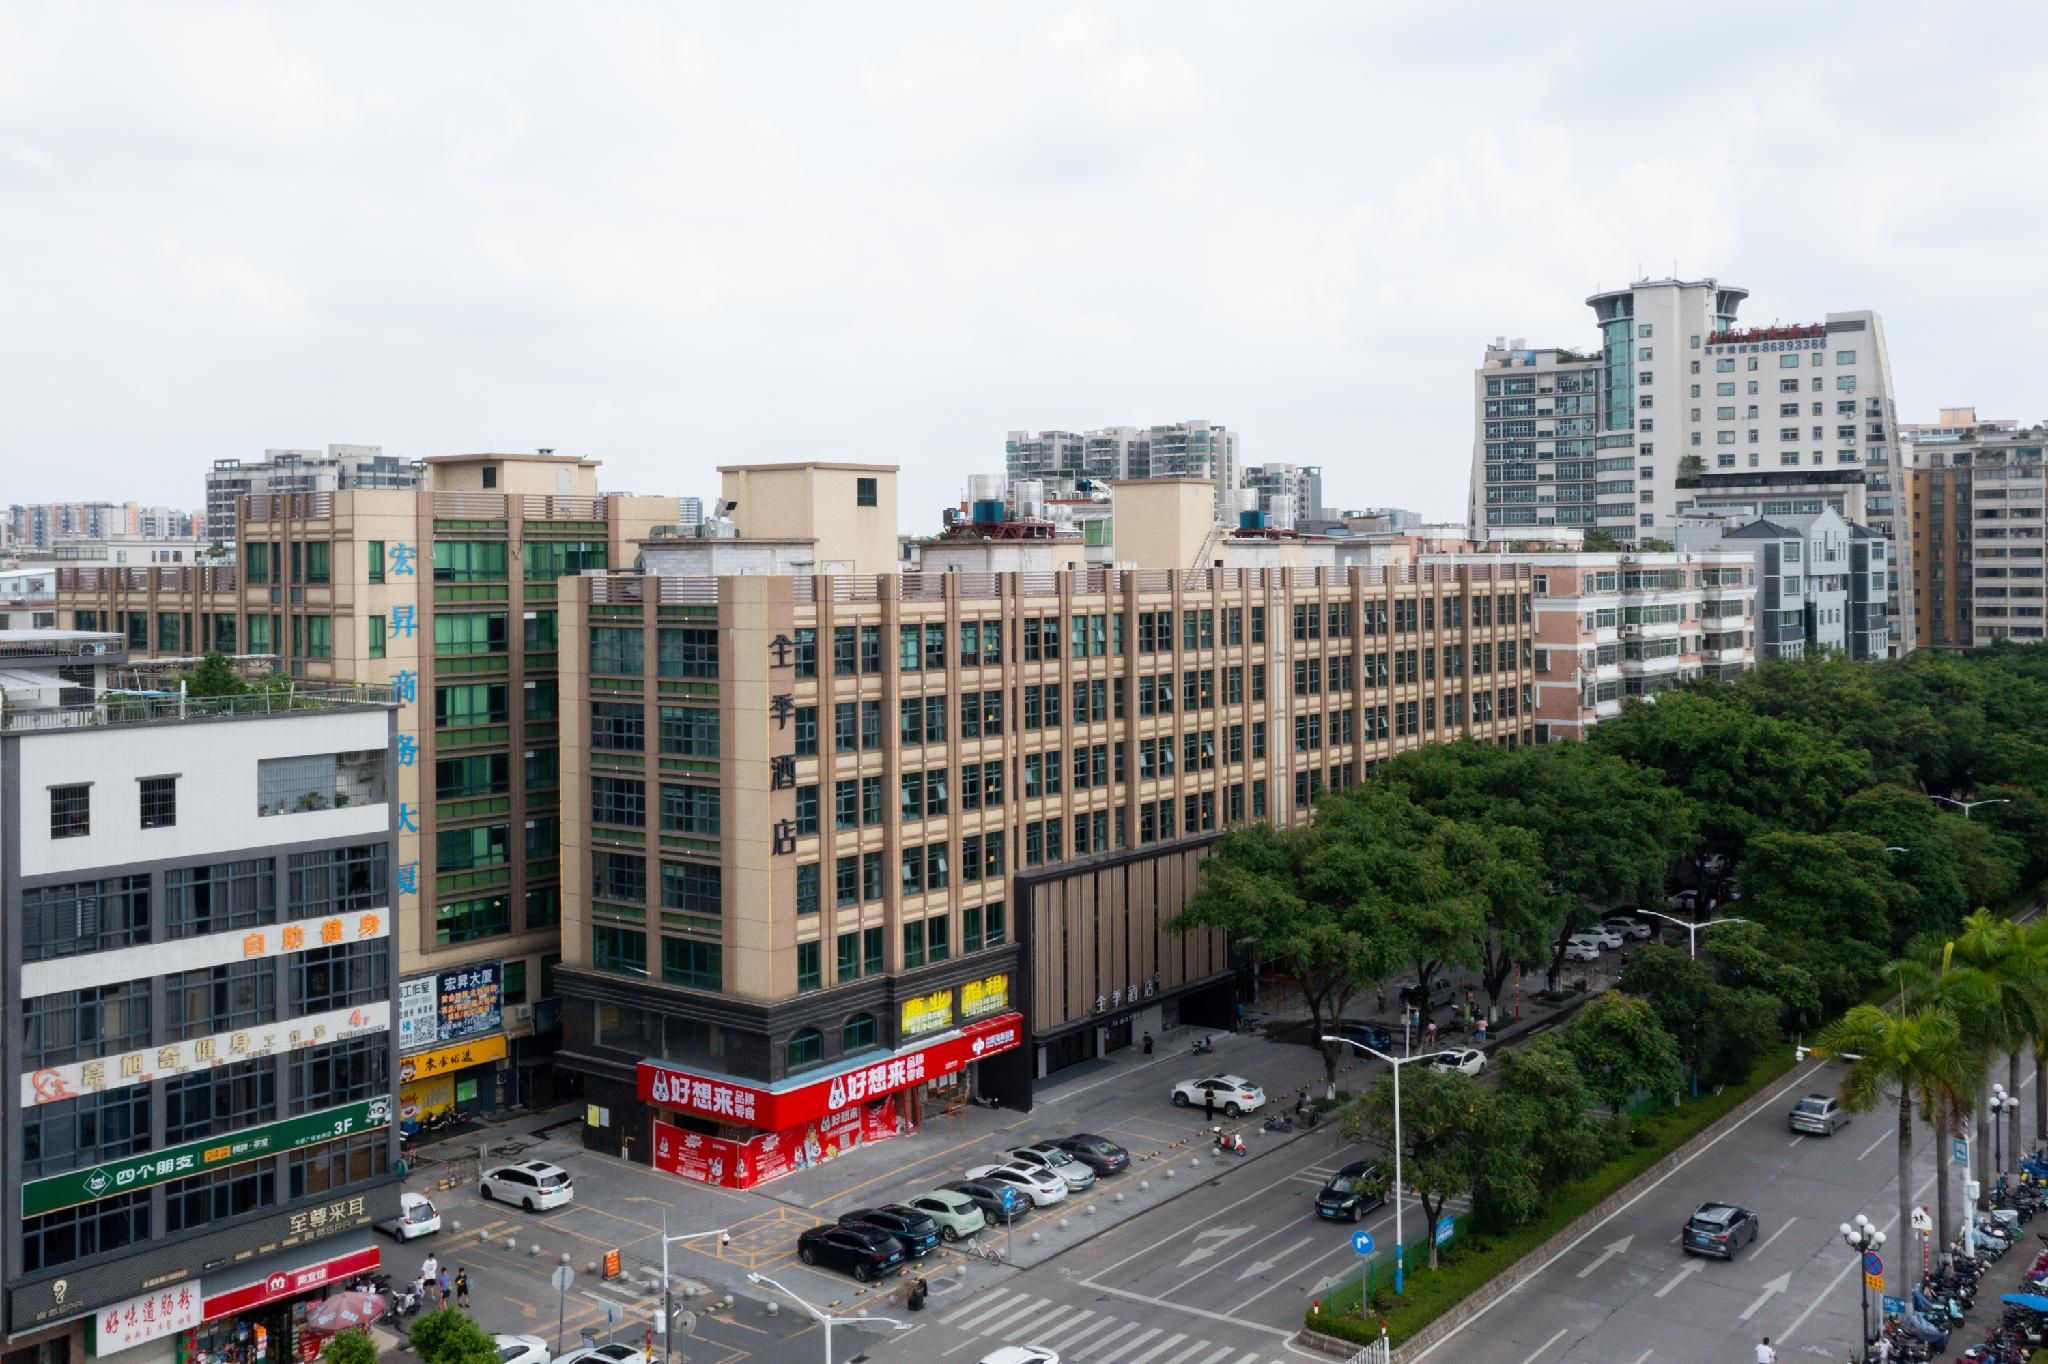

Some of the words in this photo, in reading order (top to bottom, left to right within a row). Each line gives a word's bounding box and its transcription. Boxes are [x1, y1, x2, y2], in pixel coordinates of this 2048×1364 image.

[768, 634, 796, 856] 全季酒店
[243, 913, 381, 959] 自助健身
[444, 968, 493, 991] 宏昇大厦
[965, 975, 1003, 1001] 招租
[1096, 981, 1153, 1014] 全季酒店
[907, 1053, 925, 1069] 品牌
[907, 1066, 925, 1082] 零食
[847, 1059, 906, 1102] 好想来
[670, 1075, 734, 1116] 好想来
[734, 1090, 755, 1106] 品牌
[334, 1117, 353, 1135] 3F
[734, 1104, 755, 1120] 零食
[116, 1154, 194, 1186] 四个朋友
[289, 1195, 366, 1235] 至尊采耳
[297, 1268, 327, 1287] 美宜佳
[105, 1287, 193, 1334] 好味道肠粉
